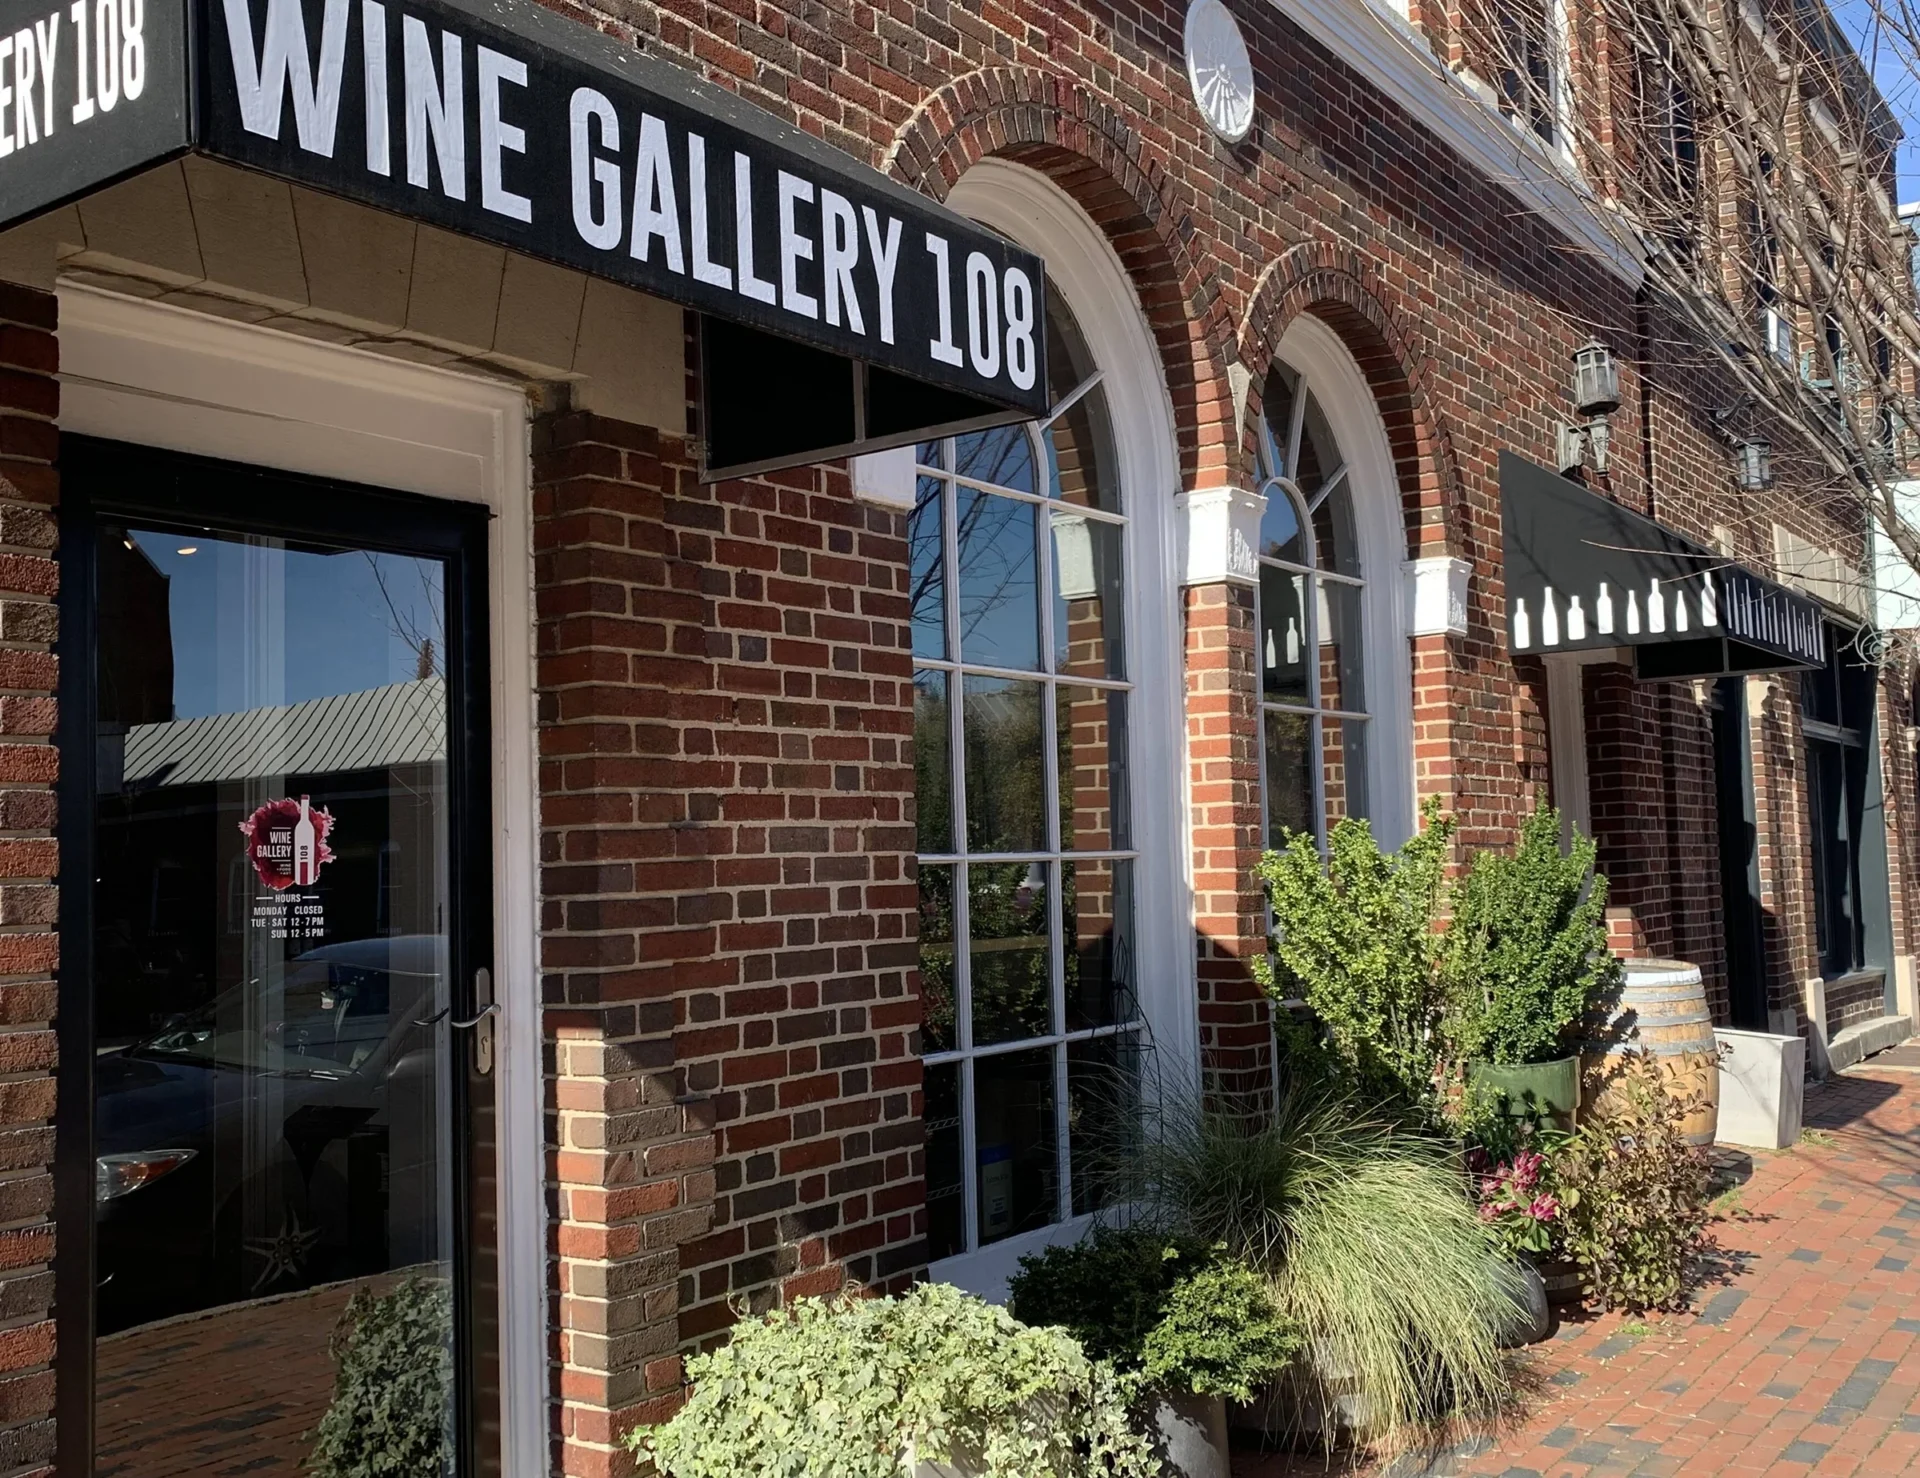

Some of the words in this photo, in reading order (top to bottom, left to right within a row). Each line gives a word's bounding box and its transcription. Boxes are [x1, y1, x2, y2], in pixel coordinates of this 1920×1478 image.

[71, 0, 145, 125] 108
[223, 0, 532, 224] WINE
[570, 87, 903, 346] GALLERY
[926, 232, 1036, 391] 108
[270, 831, 291, 844] WINE
[257, 845, 291, 858] GALLERY
[300, 845, 308, 860] 108
[275, 894, 301, 903] HOURS
[254, 907, 287, 915] MONDAY
[294, 906, 323, 915] CLOSED
[251, 918, 266, 927] TUE
[272, 918, 287, 927] SAT
[291, 918, 300, 926] 12
[306, 917, 310, 926] 7
[312, 917, 324, 925] PM
[271, 929, 287, 938] SUN
[291, 929, 300, 938] 12
[306, 929, 310, 937] 5
[312, 928, 324, 937] PM
